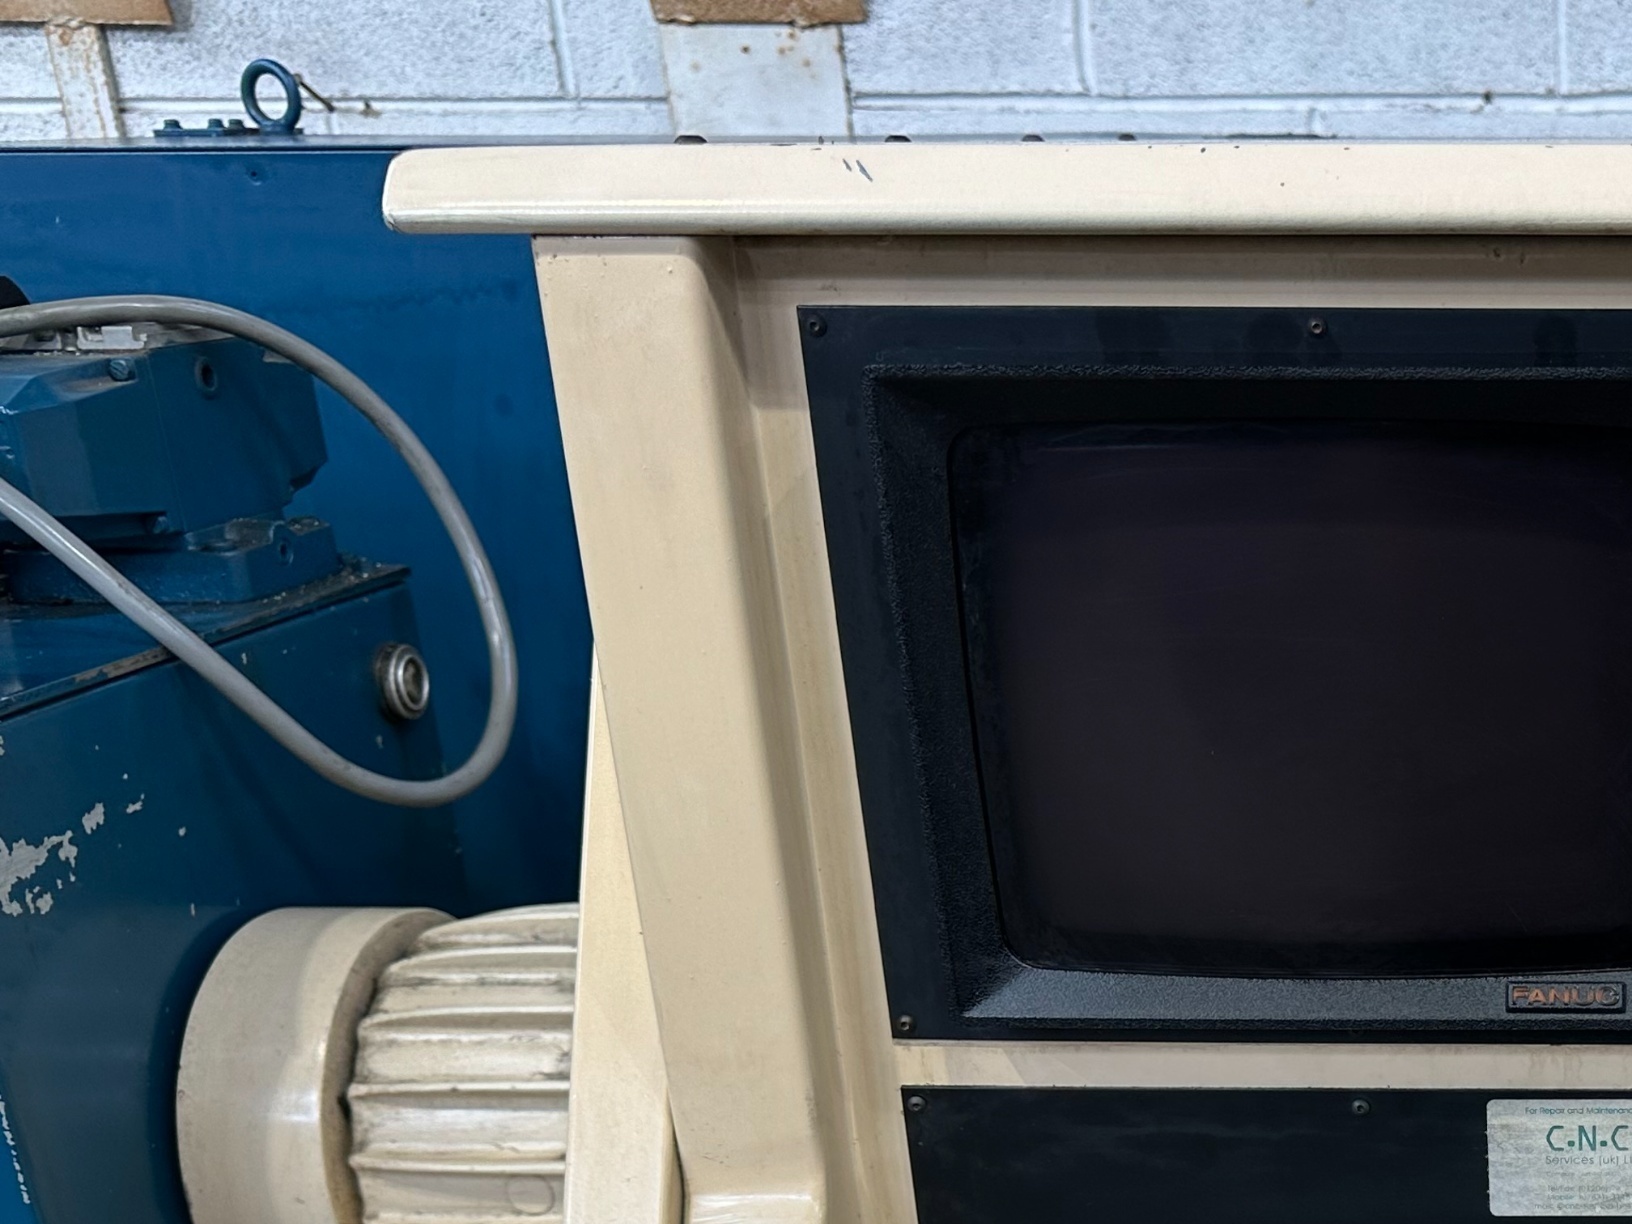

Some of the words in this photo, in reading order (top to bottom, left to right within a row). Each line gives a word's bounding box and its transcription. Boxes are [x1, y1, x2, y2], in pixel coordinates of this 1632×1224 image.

[1511, 984, 1619, 1006] FANUC
[1540, 1107, 1565, 1115] Repair
[1546, 1156, 1594, 1164] Services
